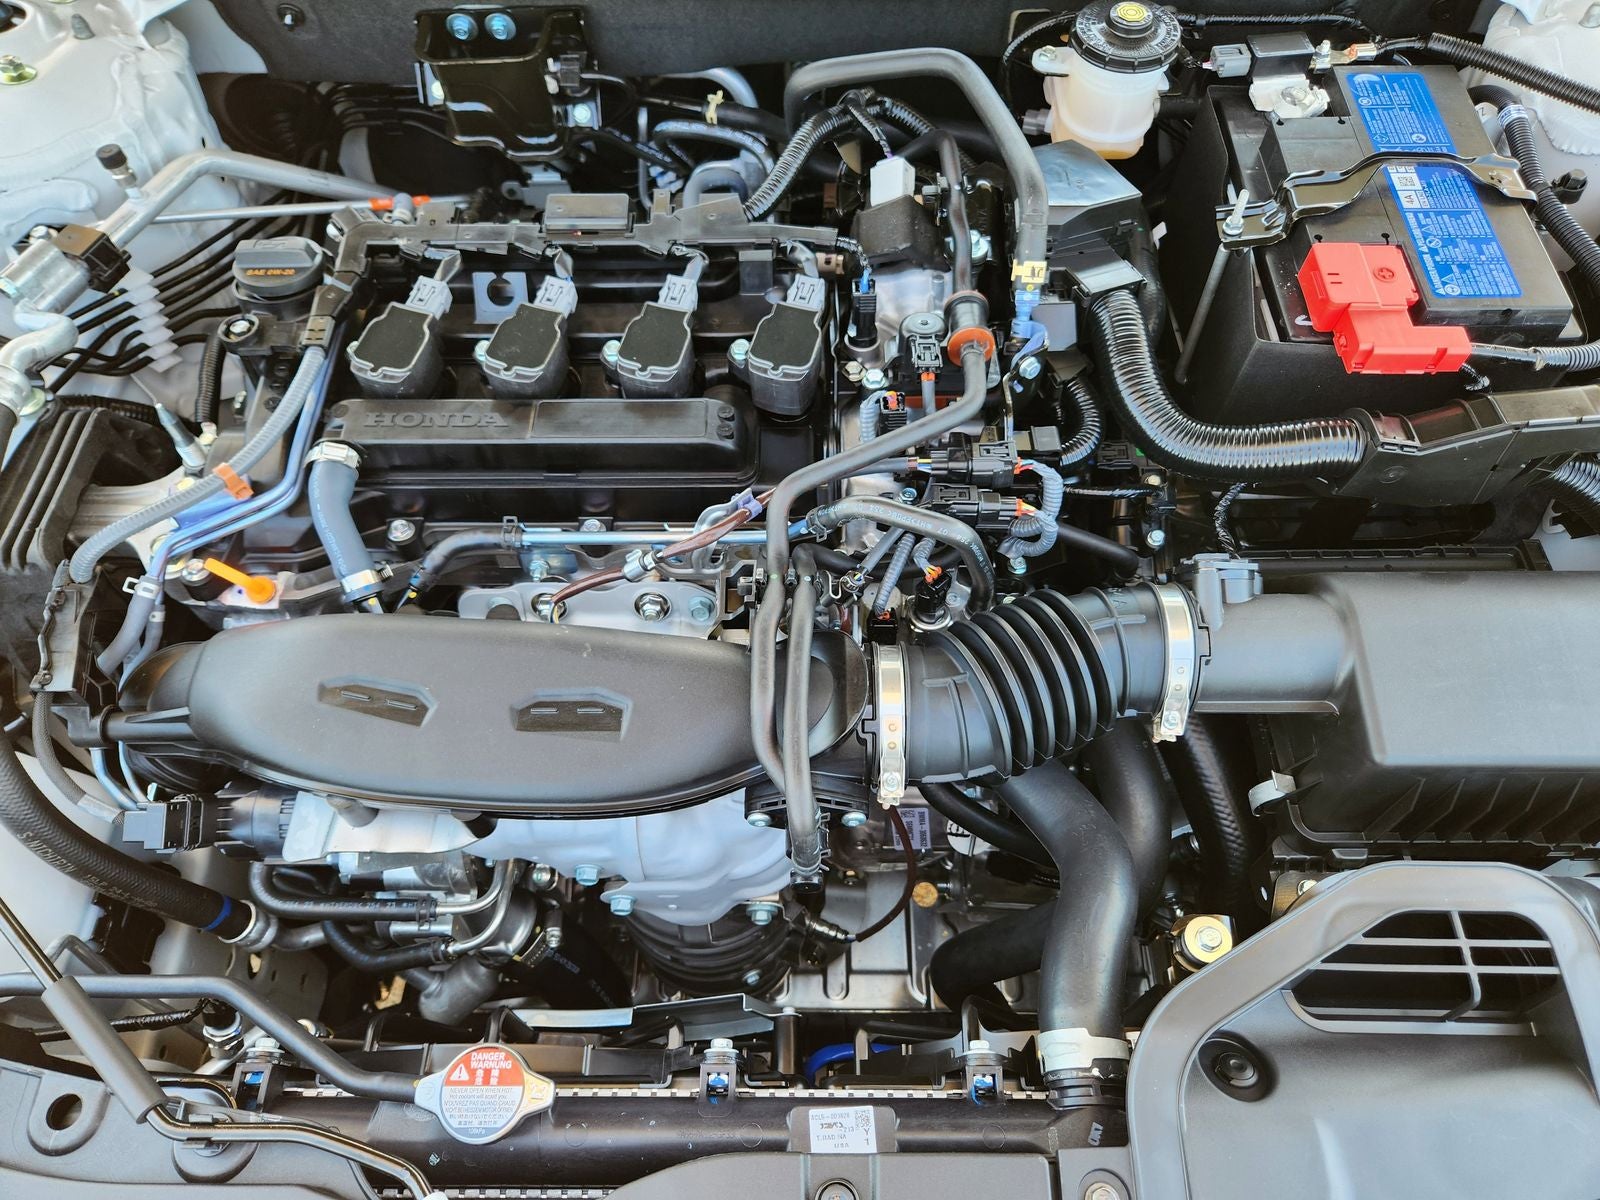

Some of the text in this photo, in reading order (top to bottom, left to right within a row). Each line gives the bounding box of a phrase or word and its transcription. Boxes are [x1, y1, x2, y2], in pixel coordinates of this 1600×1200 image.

[363, 412, 509, 428] HONDA
[471, 1052, 506, 1060] DANGER
[470, 1060, 512, 1069] WARNUNG
